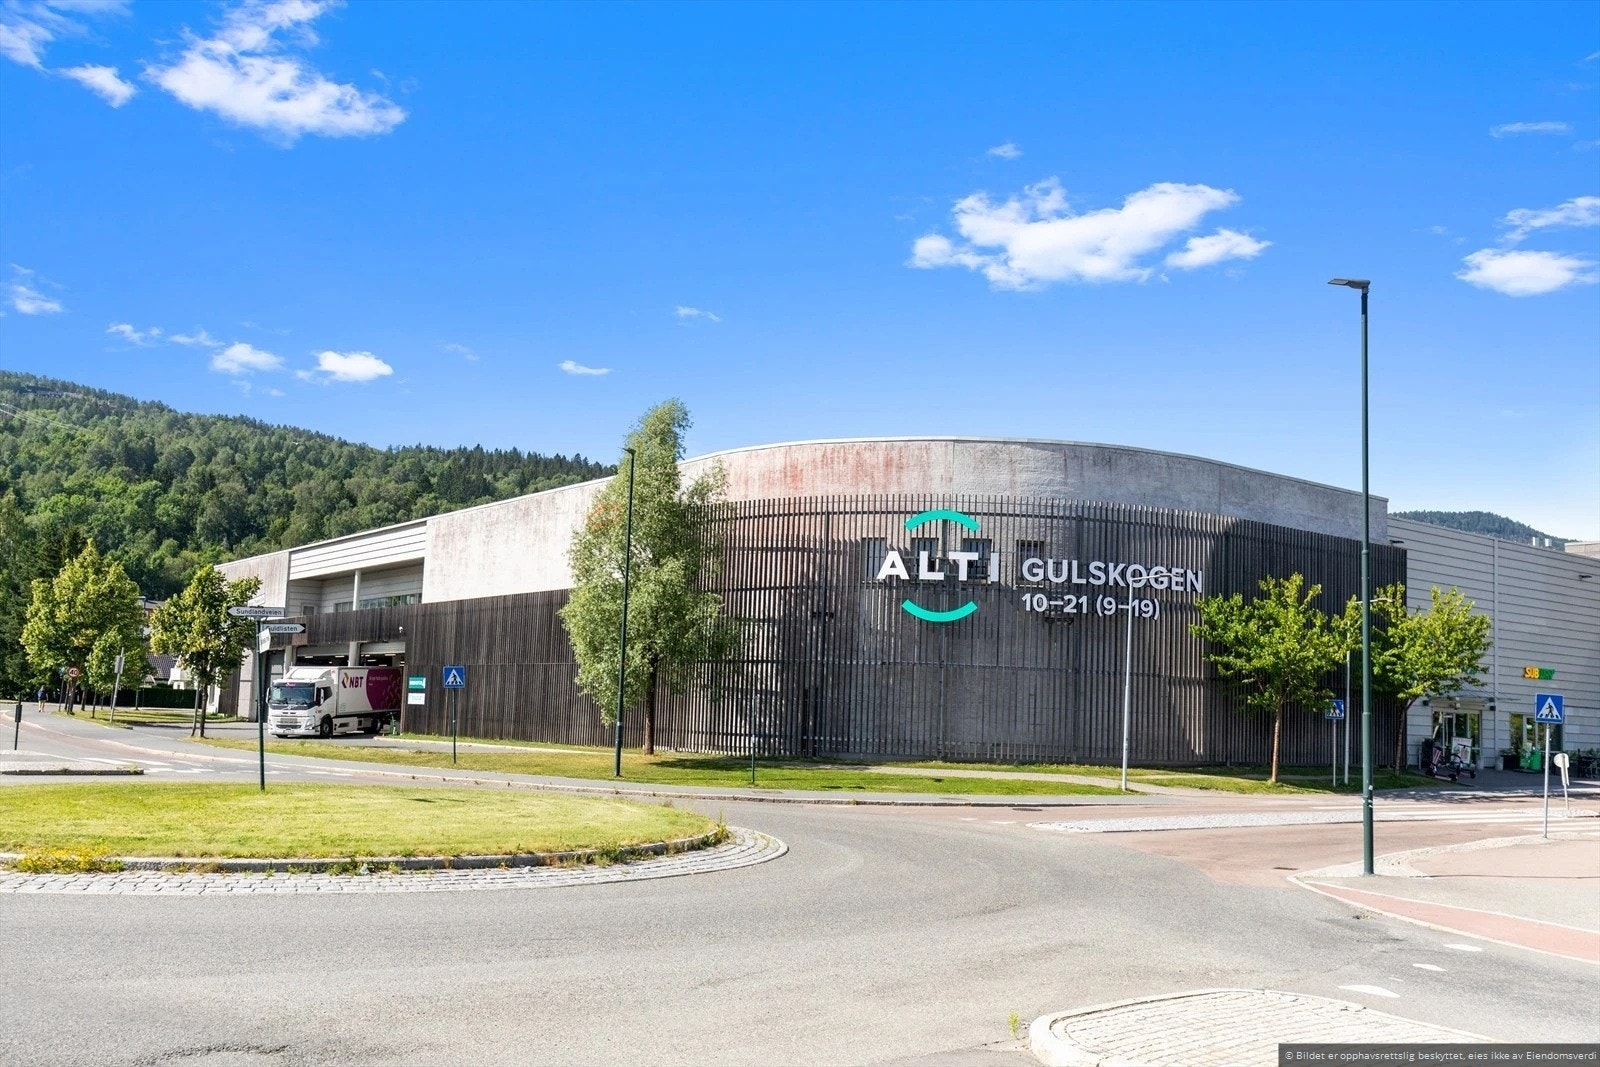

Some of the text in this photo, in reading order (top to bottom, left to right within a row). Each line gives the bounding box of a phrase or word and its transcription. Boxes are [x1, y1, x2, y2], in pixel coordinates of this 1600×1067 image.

[876, 550, 1203, 593] ALTI GULSKOGEN
[236, 608, 282, 616] Sundlandveien
[349, 676, 364, 689] NBT
